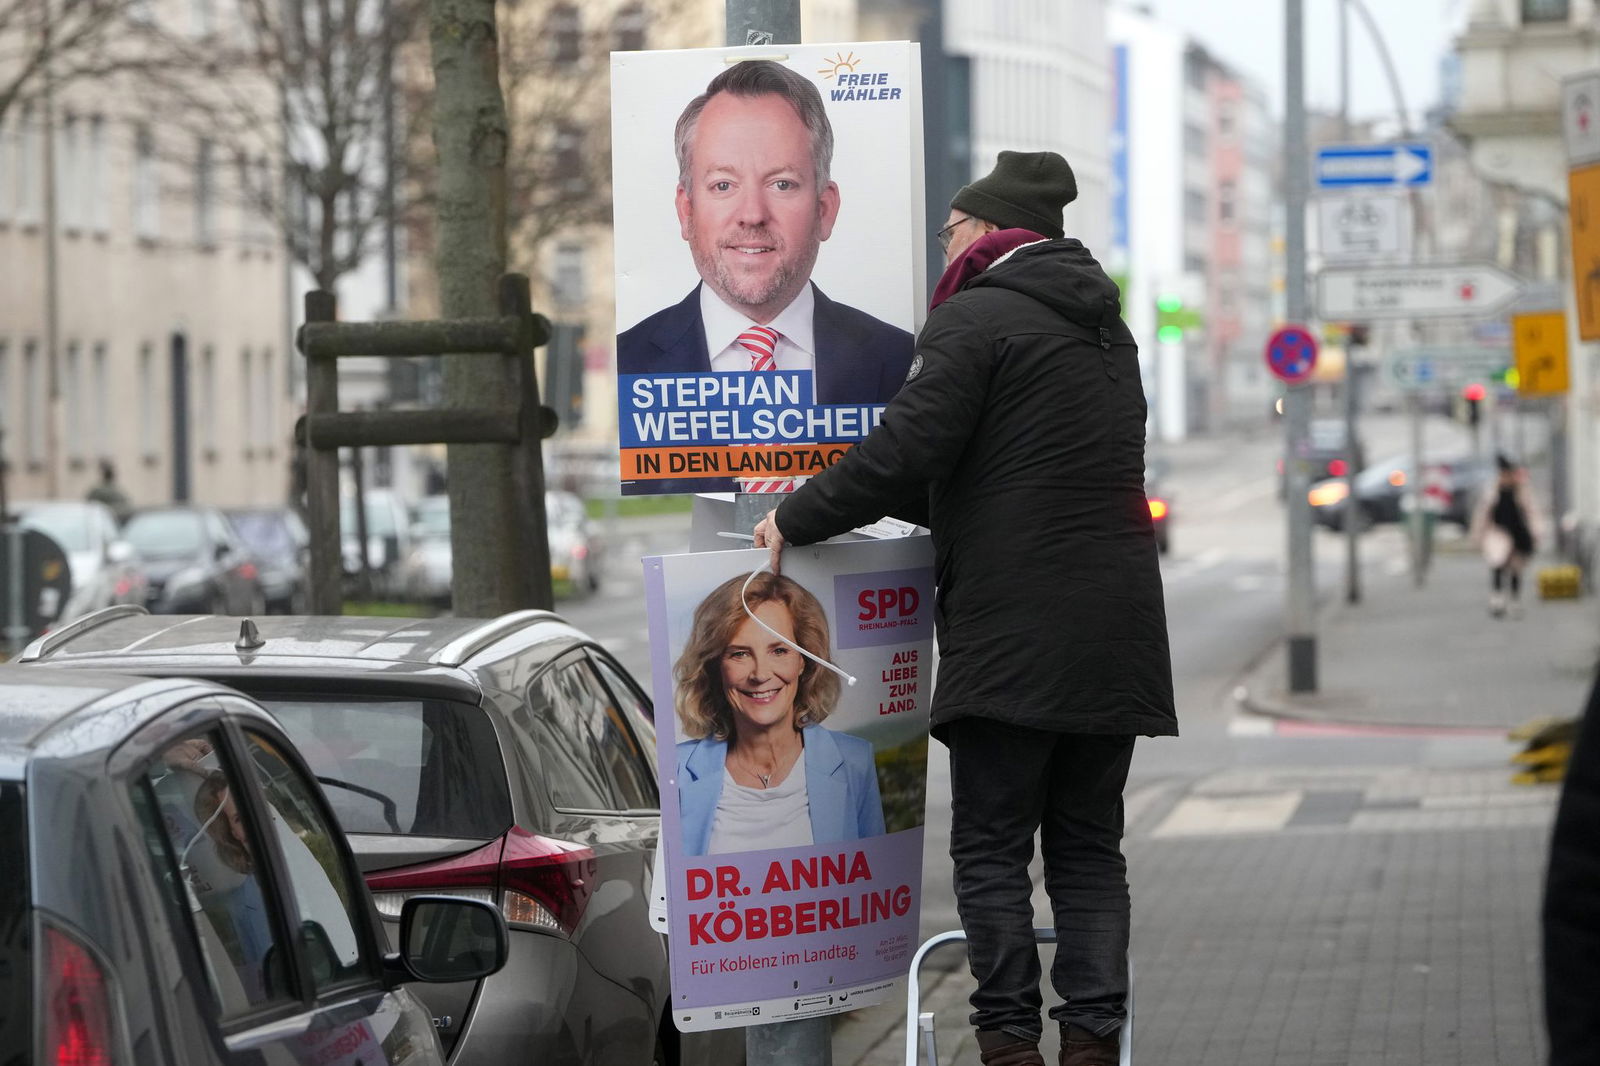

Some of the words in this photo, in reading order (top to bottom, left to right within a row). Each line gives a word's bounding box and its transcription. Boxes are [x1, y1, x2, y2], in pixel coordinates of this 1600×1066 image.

[837, 73, 888, 86] FREIE
[831, 86, 902, 101] WÄHLER
[632, 375, 800, 409] STEPHAN
[636, 453, 661, 474] IN
[669, 452, 719, 473] DEN
[858, 586, 919, 621] SPD
[859, 618, 918, 631] RHEINLAND-PFALZ
[892, 650, 918, 665] AUS
[882, 666, 918, 683] LIEBE
[889, 682, 917, 697] ZUM
[880, 699, 917, 715] LAND.
[686, 865, 751, 901] DR.
[761, 851, 872, 894] ANNA
[688, 885, 912, 946] KÖBBERLING
[691, 961, 715, 975] Für
[719, 954, 778, 973] Koblenz
[782, 951, 799, 966] im
[804, 945, 859, 962] Landtag.
